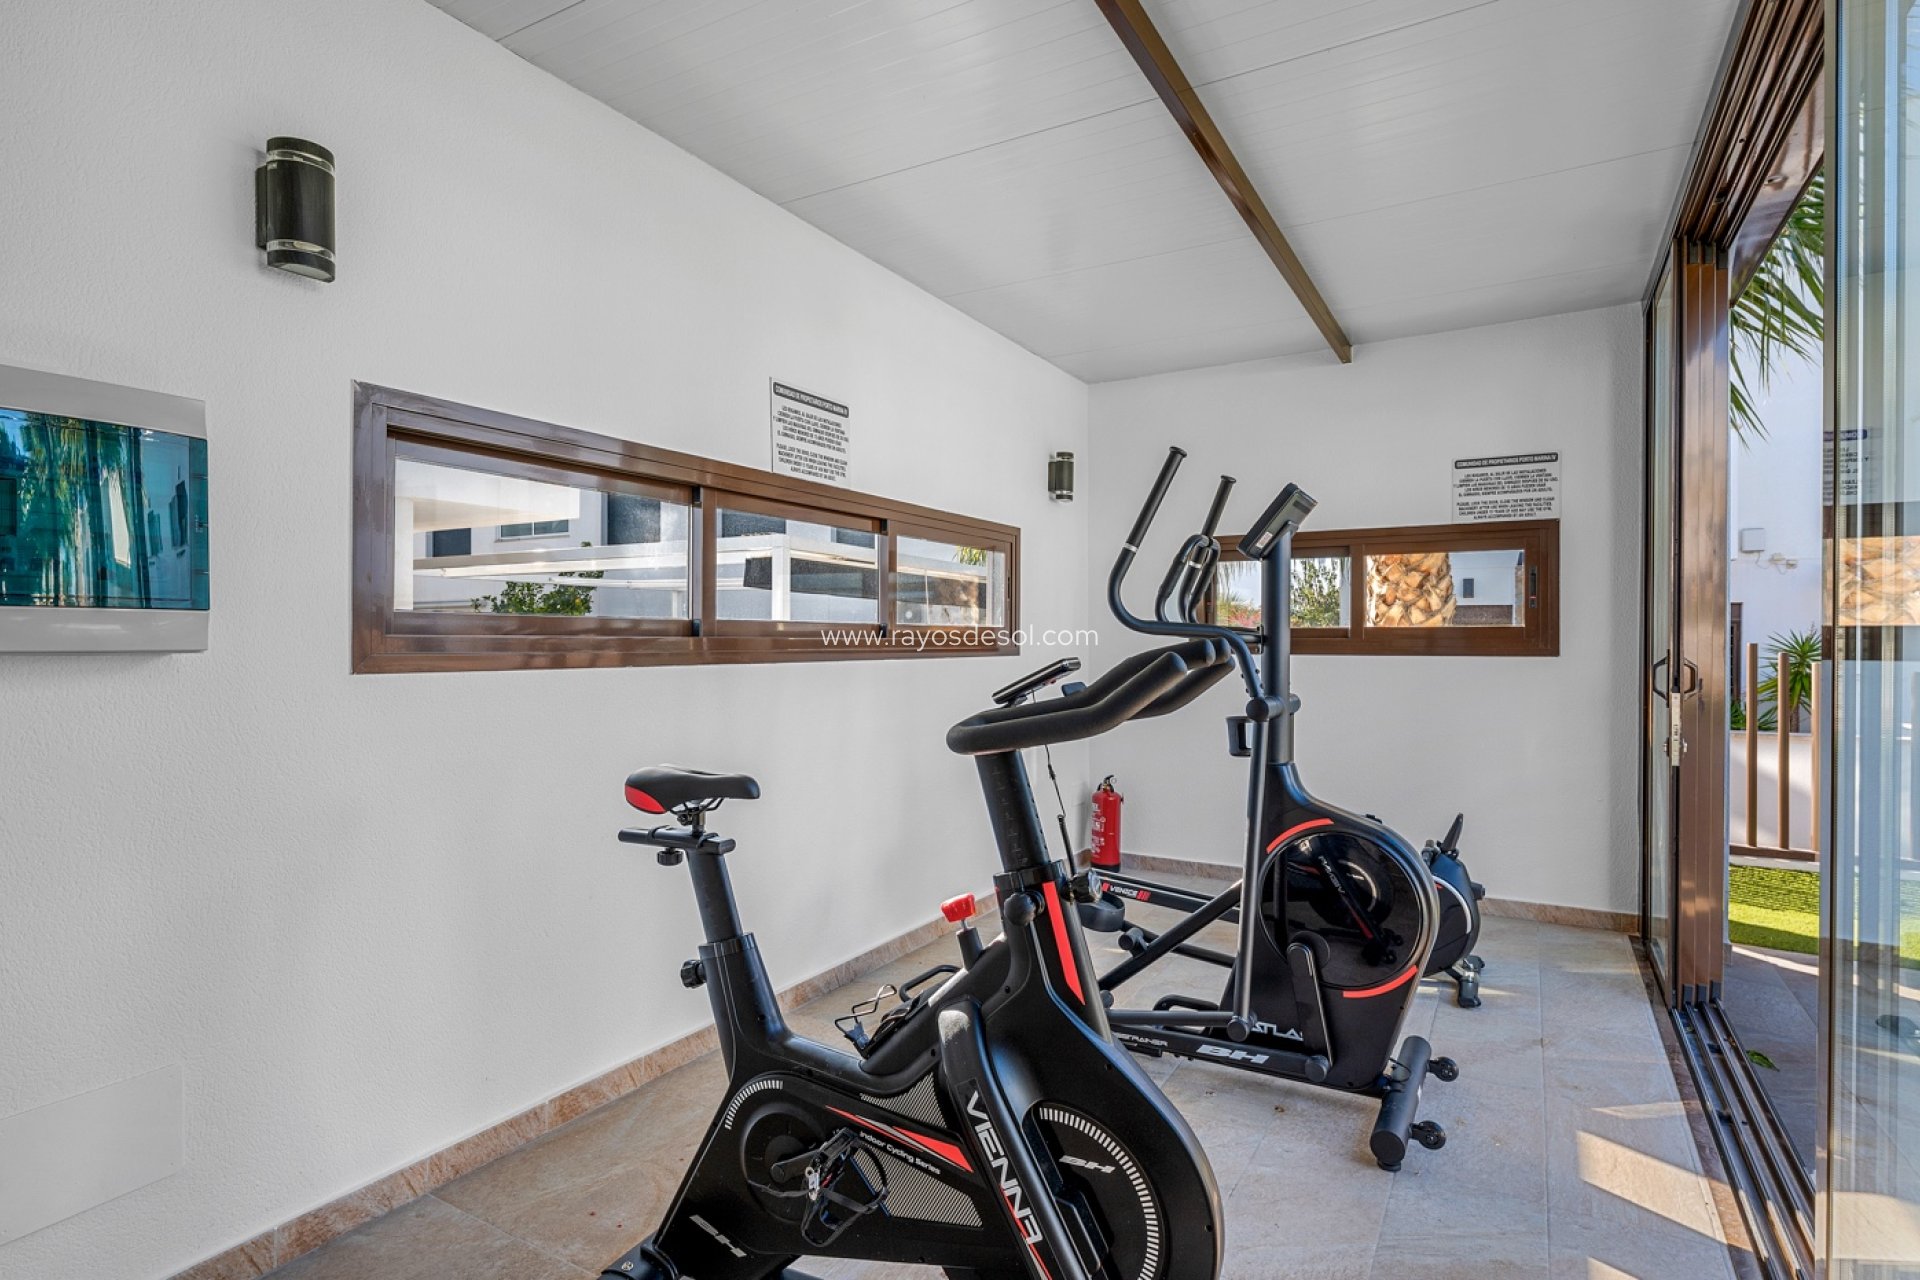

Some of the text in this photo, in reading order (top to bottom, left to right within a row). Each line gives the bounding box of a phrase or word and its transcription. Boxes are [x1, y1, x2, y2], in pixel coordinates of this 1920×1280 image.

[1196, 1044, 1269, 1064] BH
[860, 1130, 941, 1174] Indoor Cycling Series
[1059, 1155, 1116, 1174] BH
